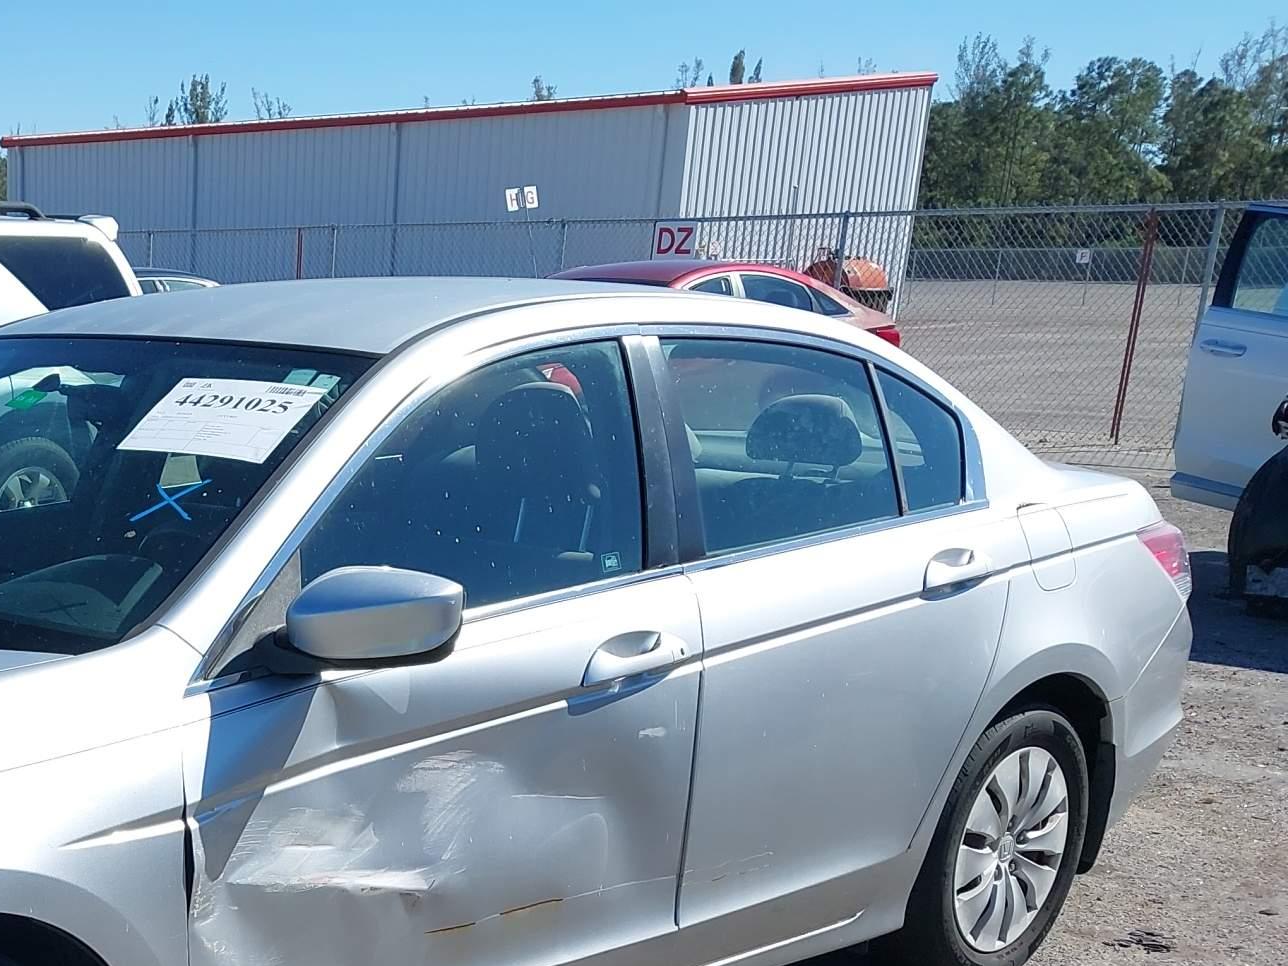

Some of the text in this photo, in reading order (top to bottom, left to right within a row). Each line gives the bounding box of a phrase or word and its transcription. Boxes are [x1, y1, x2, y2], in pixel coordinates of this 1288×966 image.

[525, 190, 535, 205] G
[656, 227, 694, 255] DZ
[175, 393, 294, 414] 44291025
